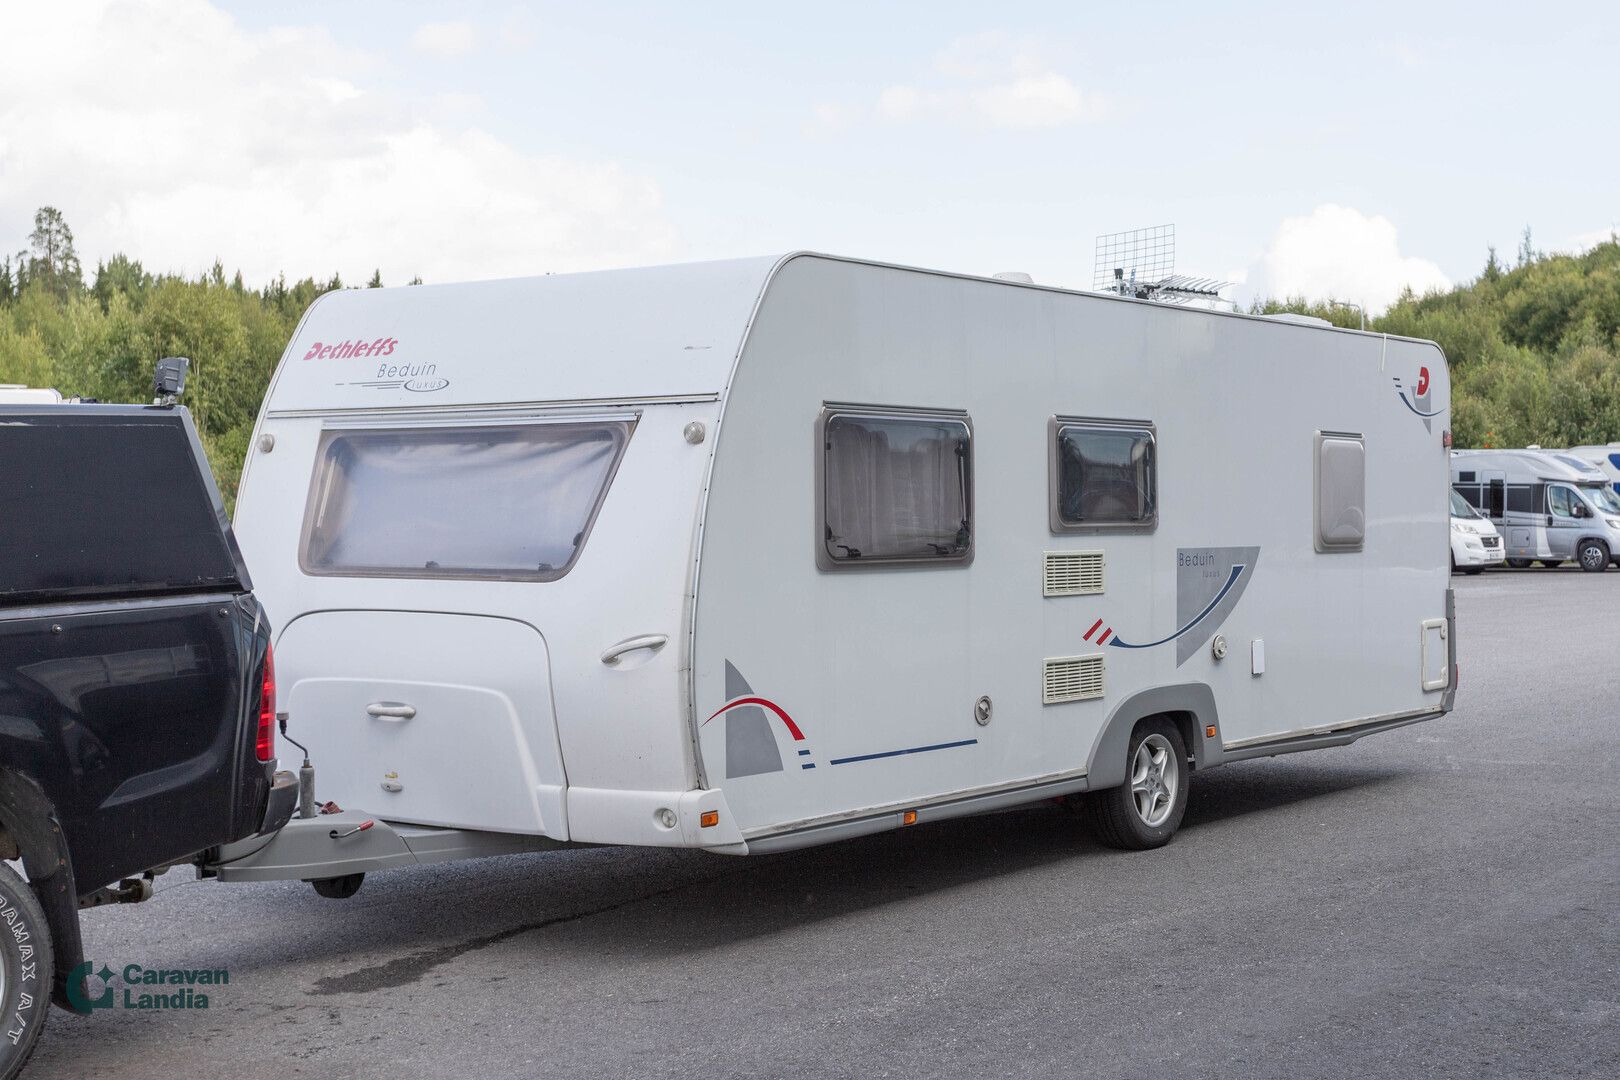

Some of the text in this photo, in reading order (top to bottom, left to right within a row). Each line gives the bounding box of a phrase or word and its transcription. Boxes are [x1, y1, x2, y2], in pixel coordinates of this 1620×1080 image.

[303, 337, 398, 361] Dethleffs
[377, 361, 436, 378] Beduin
[1179, 552, 1215, 567] Beduin
[8, 992, 33, 1045] A/T
